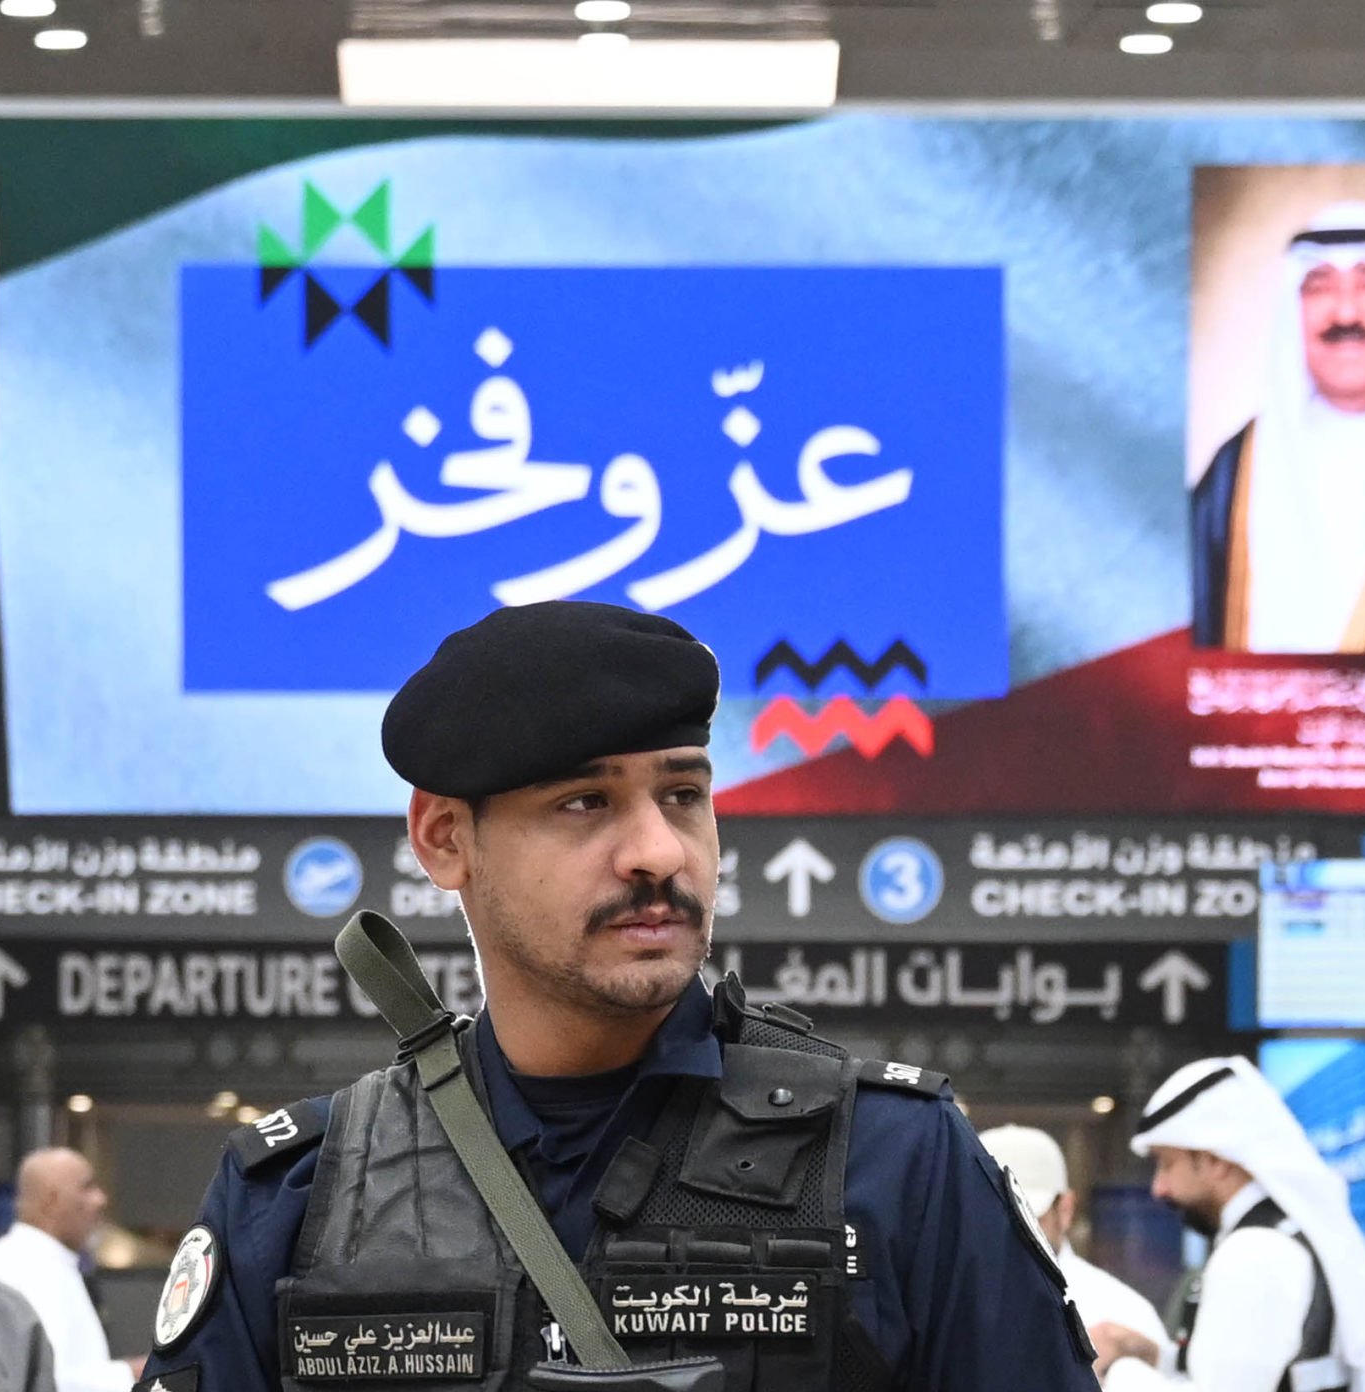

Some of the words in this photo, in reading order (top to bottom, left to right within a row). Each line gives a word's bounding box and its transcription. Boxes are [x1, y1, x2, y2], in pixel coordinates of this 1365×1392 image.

[146, 879, 259, 916] ZONE
[880, 852, 924, 910] 3
[971, 878, 1186, 917] CHECK-IN
[1193, 879, 1258, 917] ZO
[57, 952, 340, 1016] DEPARTURE
[897, 948, 1122, 1024] بوابات
[611, 1285, 710, 1312] الكويت
[719, 1281, 808, 1312] شرطة
[293, 1325, 339, 1354] حسين
[344, 1323, 378, 1355] علي
[614, 1312, 711, 1334] KUWAIT
[725, 1312, 808, 1333] POLICE
